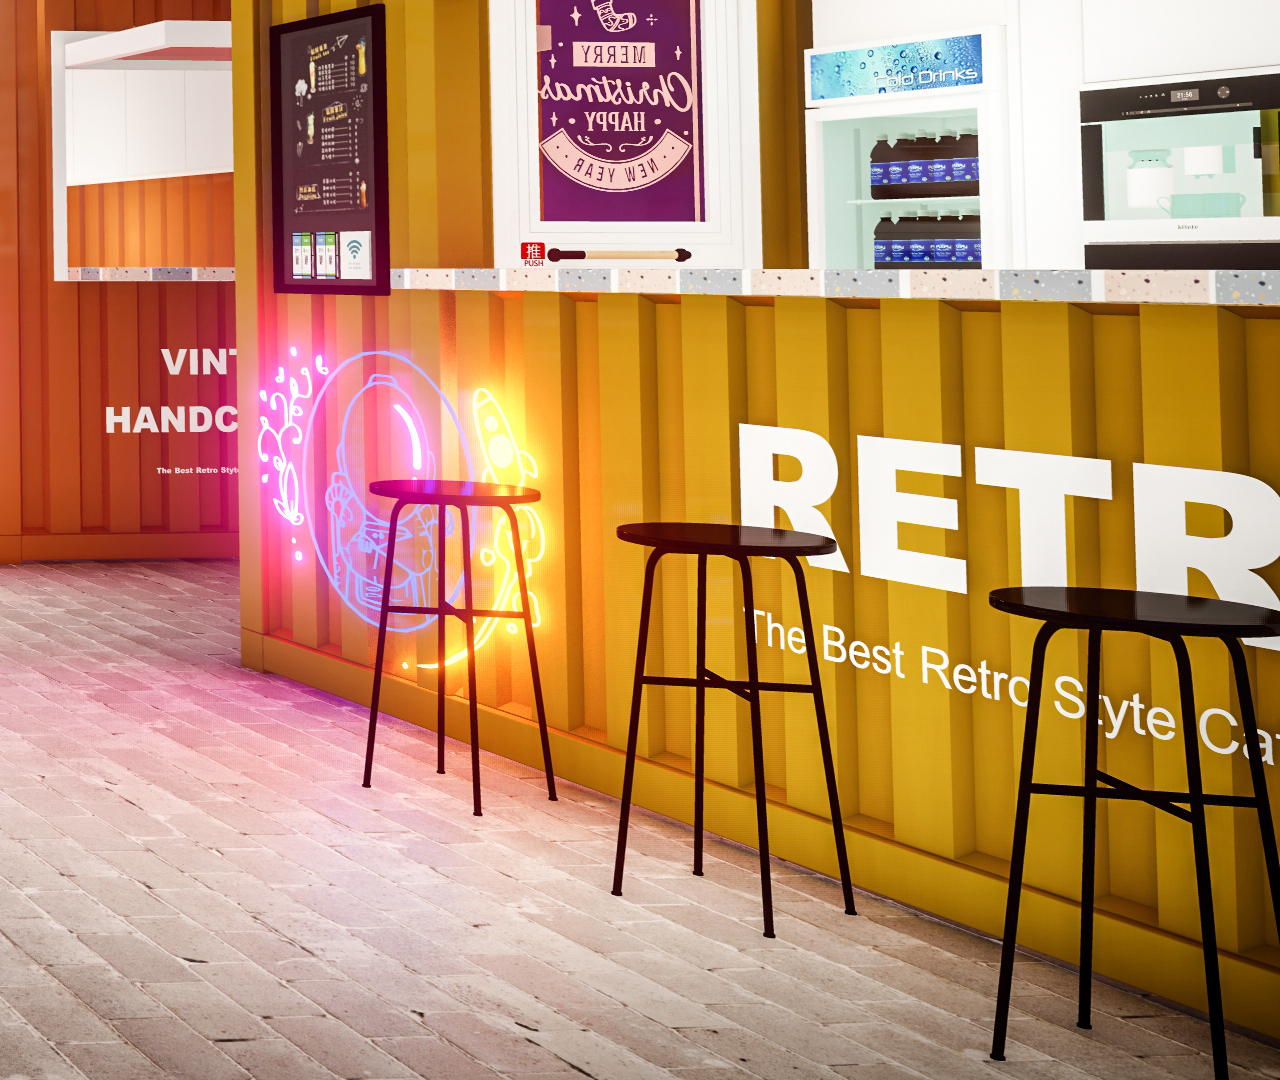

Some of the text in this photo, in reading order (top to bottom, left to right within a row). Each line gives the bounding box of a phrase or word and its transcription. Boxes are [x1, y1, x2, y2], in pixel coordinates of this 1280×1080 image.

[919, 67, 978, 85] Drinks
[524, 259, 544, 267] PUSH
[526, 244, 542, 259] 推
[105, 405, 238, 433] HANDC
[738, 422, 1280, 651] RETR
[823, 623, 905, 679] Best
[921, 645, 1030, 708] Retro
[1199, 707, 1280, 766] Ca
